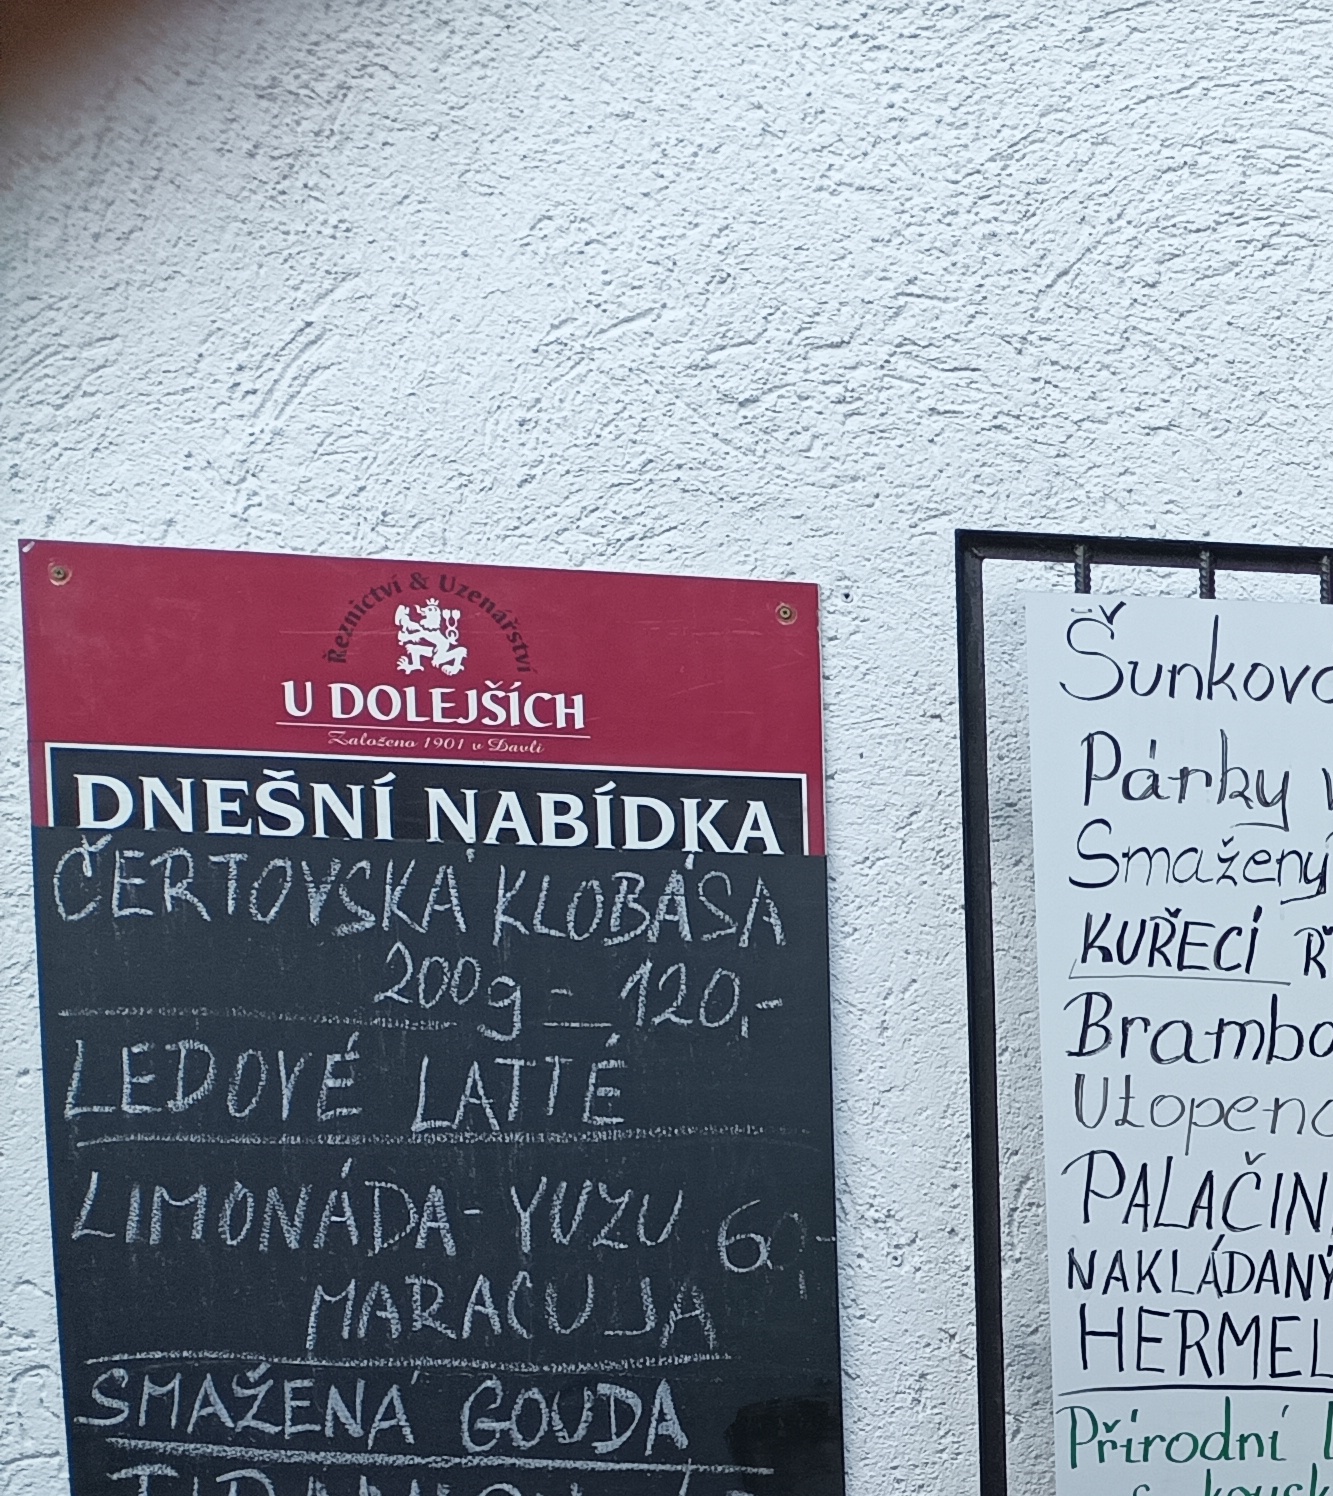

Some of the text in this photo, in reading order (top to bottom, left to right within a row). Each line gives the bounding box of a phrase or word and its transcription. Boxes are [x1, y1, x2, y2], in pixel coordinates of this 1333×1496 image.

[322, 571, 539, 675] Řeznictví & Uzenářství
[281, 680, 586, 729] U DOLEJŠÍCH
[327, 730, 545, 754] Založeno 1901 v Davli
[73, 768, 785, 856] DNEŠNÍ NABÍDKA
[1080, 728, 1291, 833] Párky
[492, 853, 788, 948] KLOBÁSA
[1079, 905, 1264, 975] KUŘECÍ
[374, 940, 522, 1041] 200g
[64, 1031, 627, 1132] LEDOVÉ LATTÉ
[510, 1176, 683, 1254] YUZU
[305, 1270, 717, 1351] MARACUJA
[74, 1362, 689, 1456] SMAŽENÁ GOUDA
[1056, 1396, 1290, 1470] Přírodní
